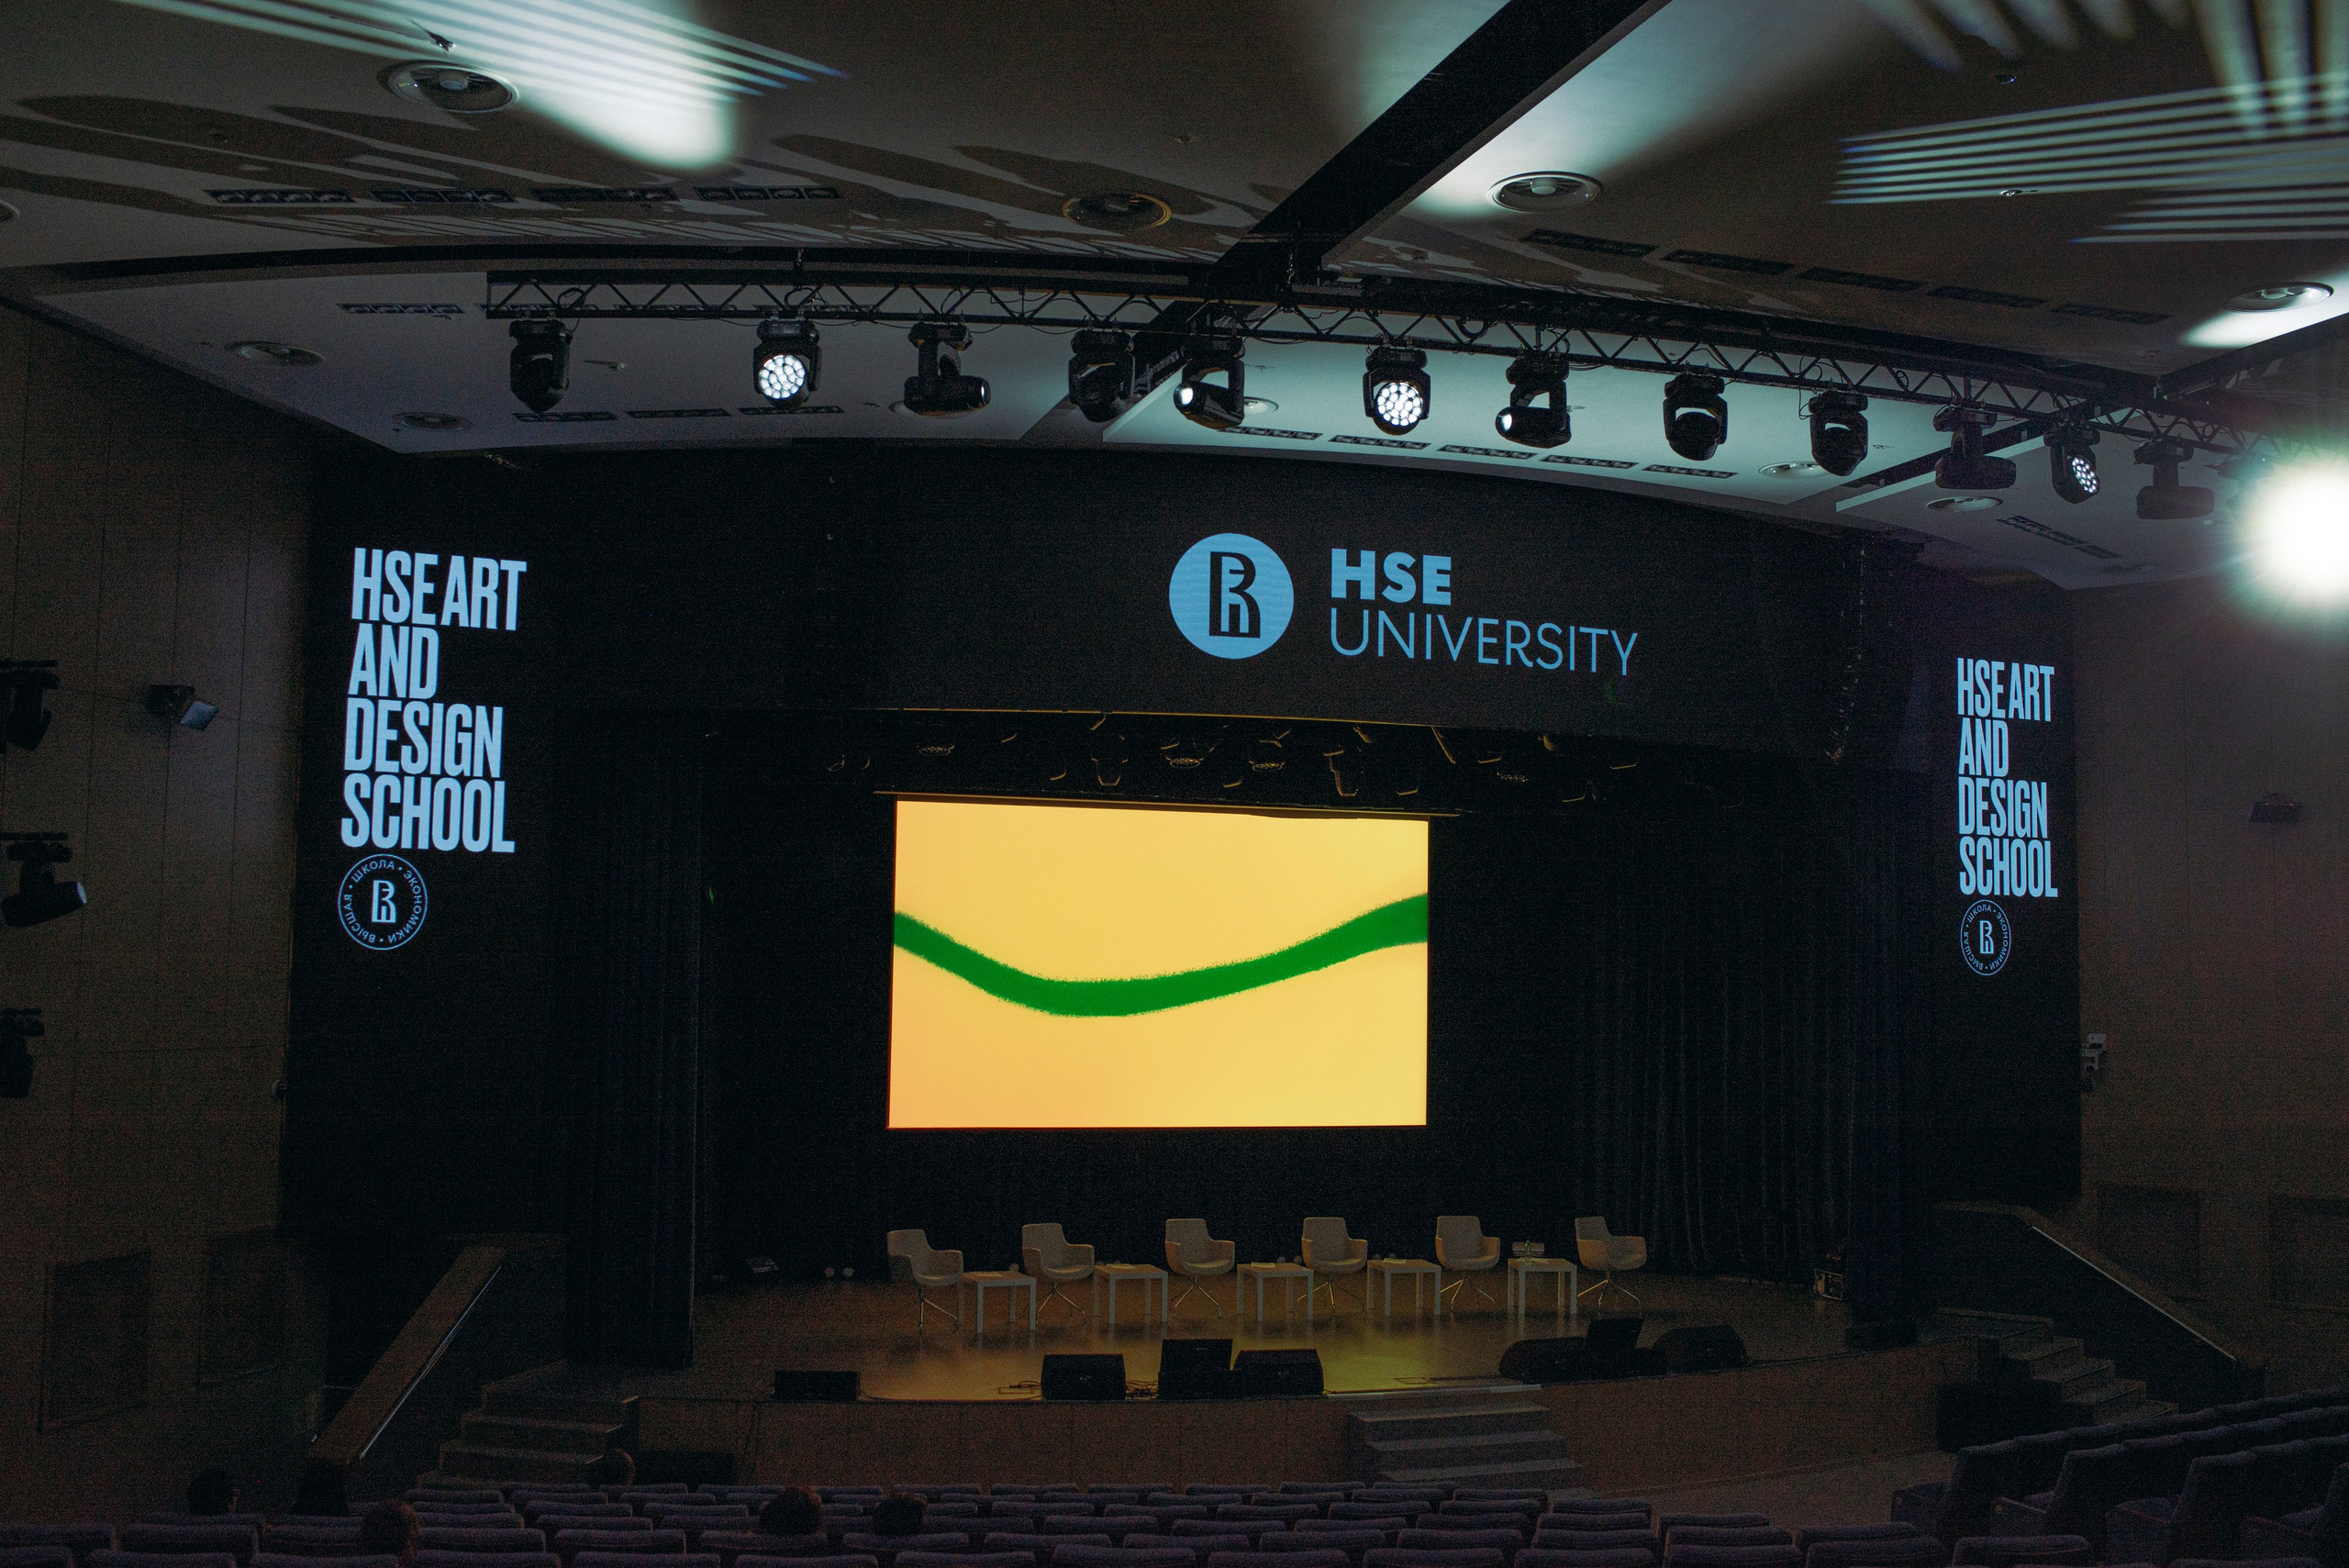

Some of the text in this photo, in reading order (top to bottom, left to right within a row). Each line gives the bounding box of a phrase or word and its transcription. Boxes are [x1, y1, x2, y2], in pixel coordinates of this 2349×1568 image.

[351, 548, 528, 631] HSE ART
[1330, 548, 1453, 606] HSE
[347, 622, 440, 700] AND
[1330, 606, 1639, 676] UNIVERSITY
[1956, 657, 2055, 723] HSE ART
[343, 697, 504, 779] DESIGN
[1957, 717, 2009, 778] AND
[340, 773, 516, 853] SCHOOL
[1957, 775, 2048, 840] DESIGN
[1958, 835, 2059, 898] SCHOOL
[343, 860, 423, 943] ВЫСШАЯ ШКОЛА ЭКОНОМИКИ
[1966, 904, 1992, 923] ШКОЛА
